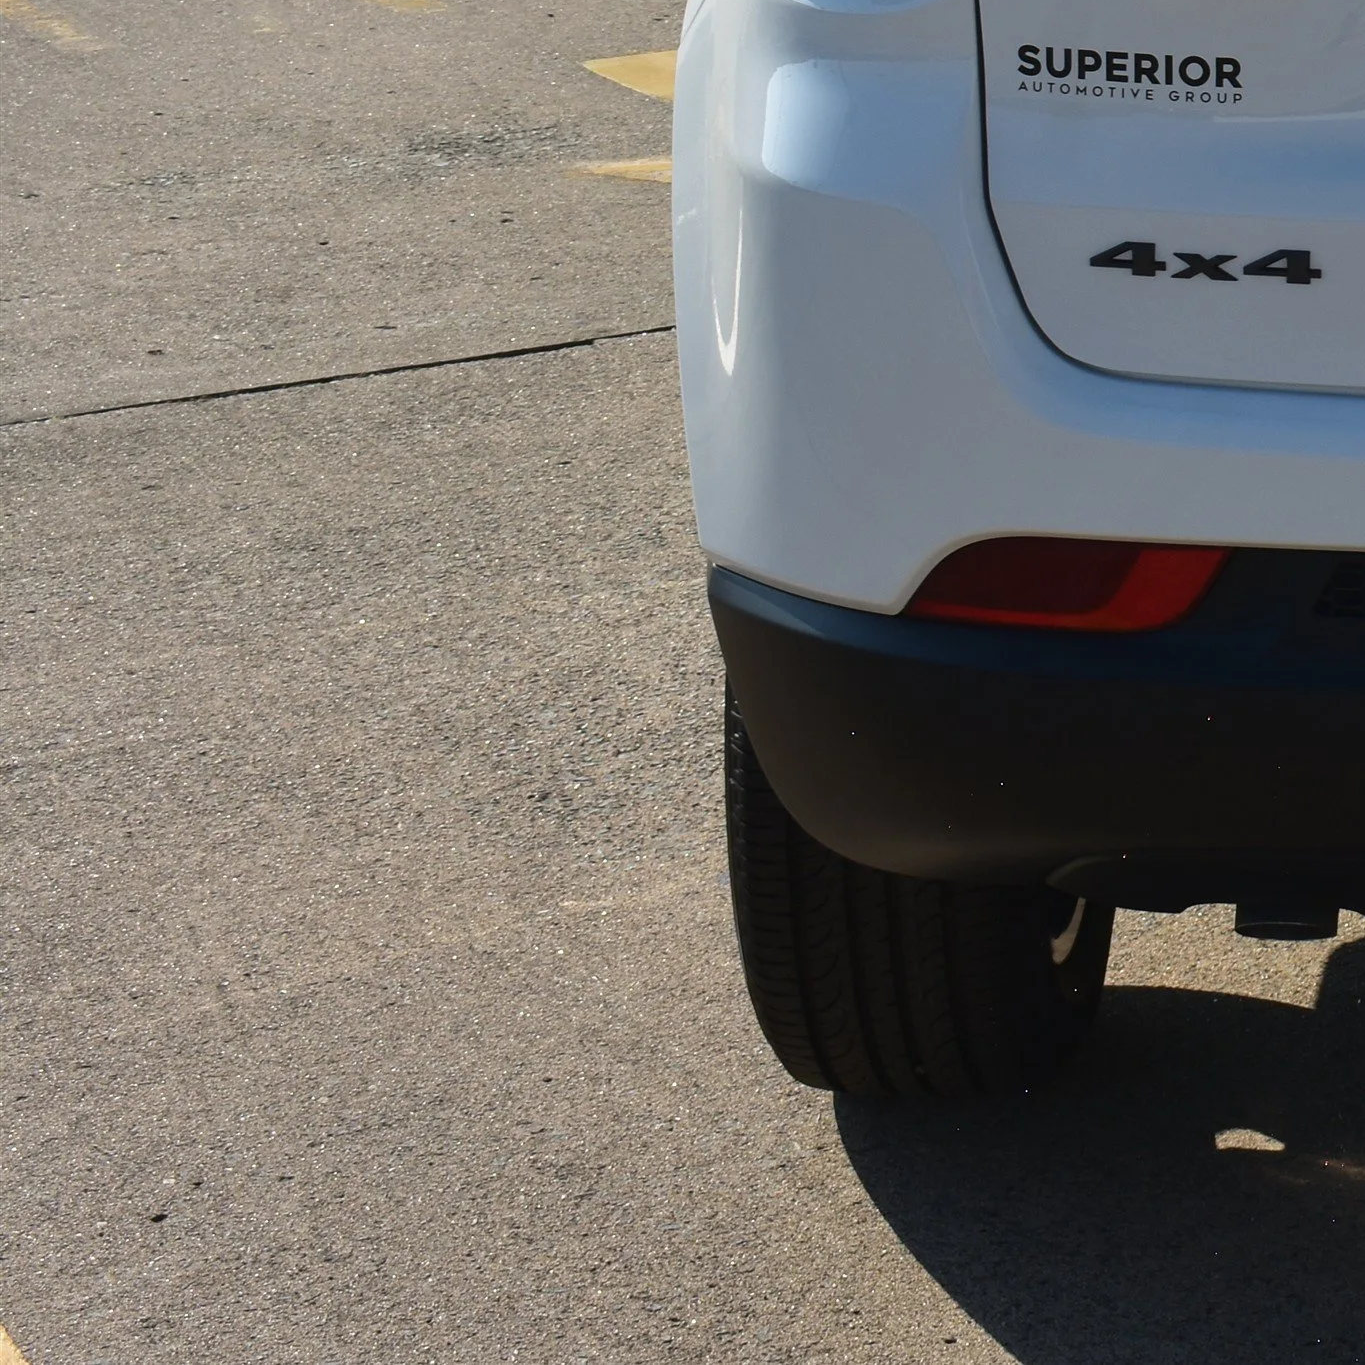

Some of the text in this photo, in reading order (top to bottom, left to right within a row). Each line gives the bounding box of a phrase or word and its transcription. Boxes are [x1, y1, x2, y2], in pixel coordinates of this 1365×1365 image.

[1017, 44, 1243, 89] SUPERIOR
[1018, 81, 1243, 104] AUTOMOTIVE GROUP
[1090, 241, 1322, 284] 4x4
